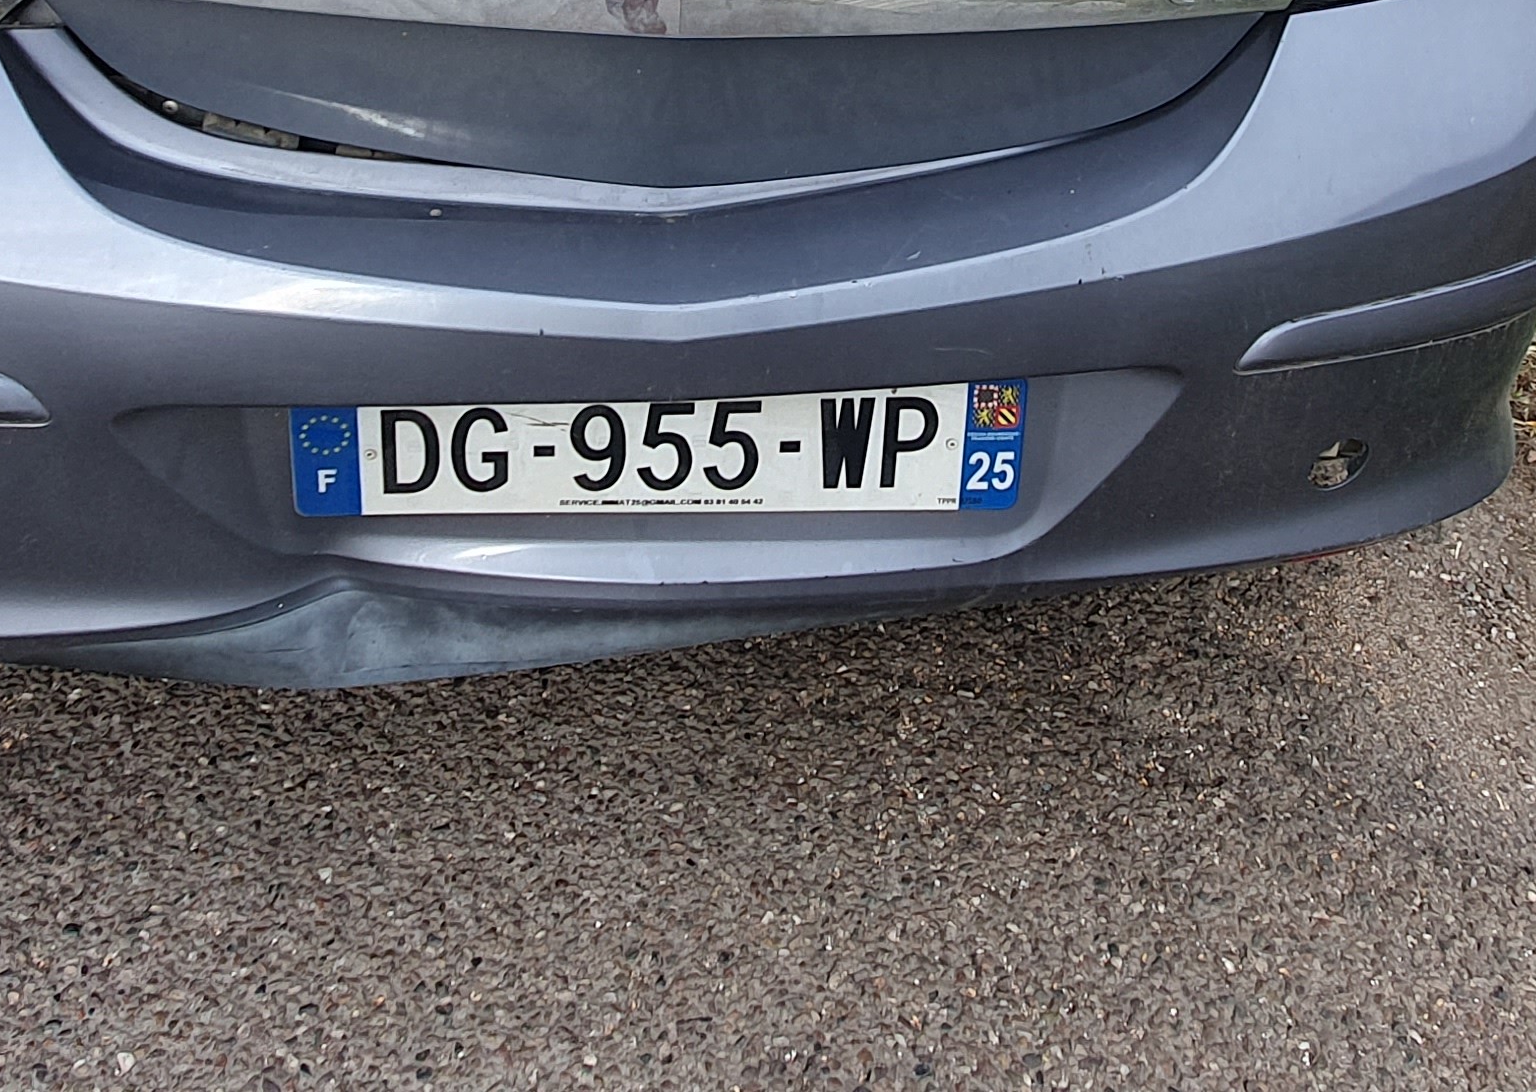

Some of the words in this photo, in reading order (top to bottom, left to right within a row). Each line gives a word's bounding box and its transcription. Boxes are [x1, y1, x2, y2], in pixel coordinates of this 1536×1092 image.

[317, 469, 336, 493] F
[379, 396, 940, 495] DG-955-WP
[966, 451, 1015, 490] 25
